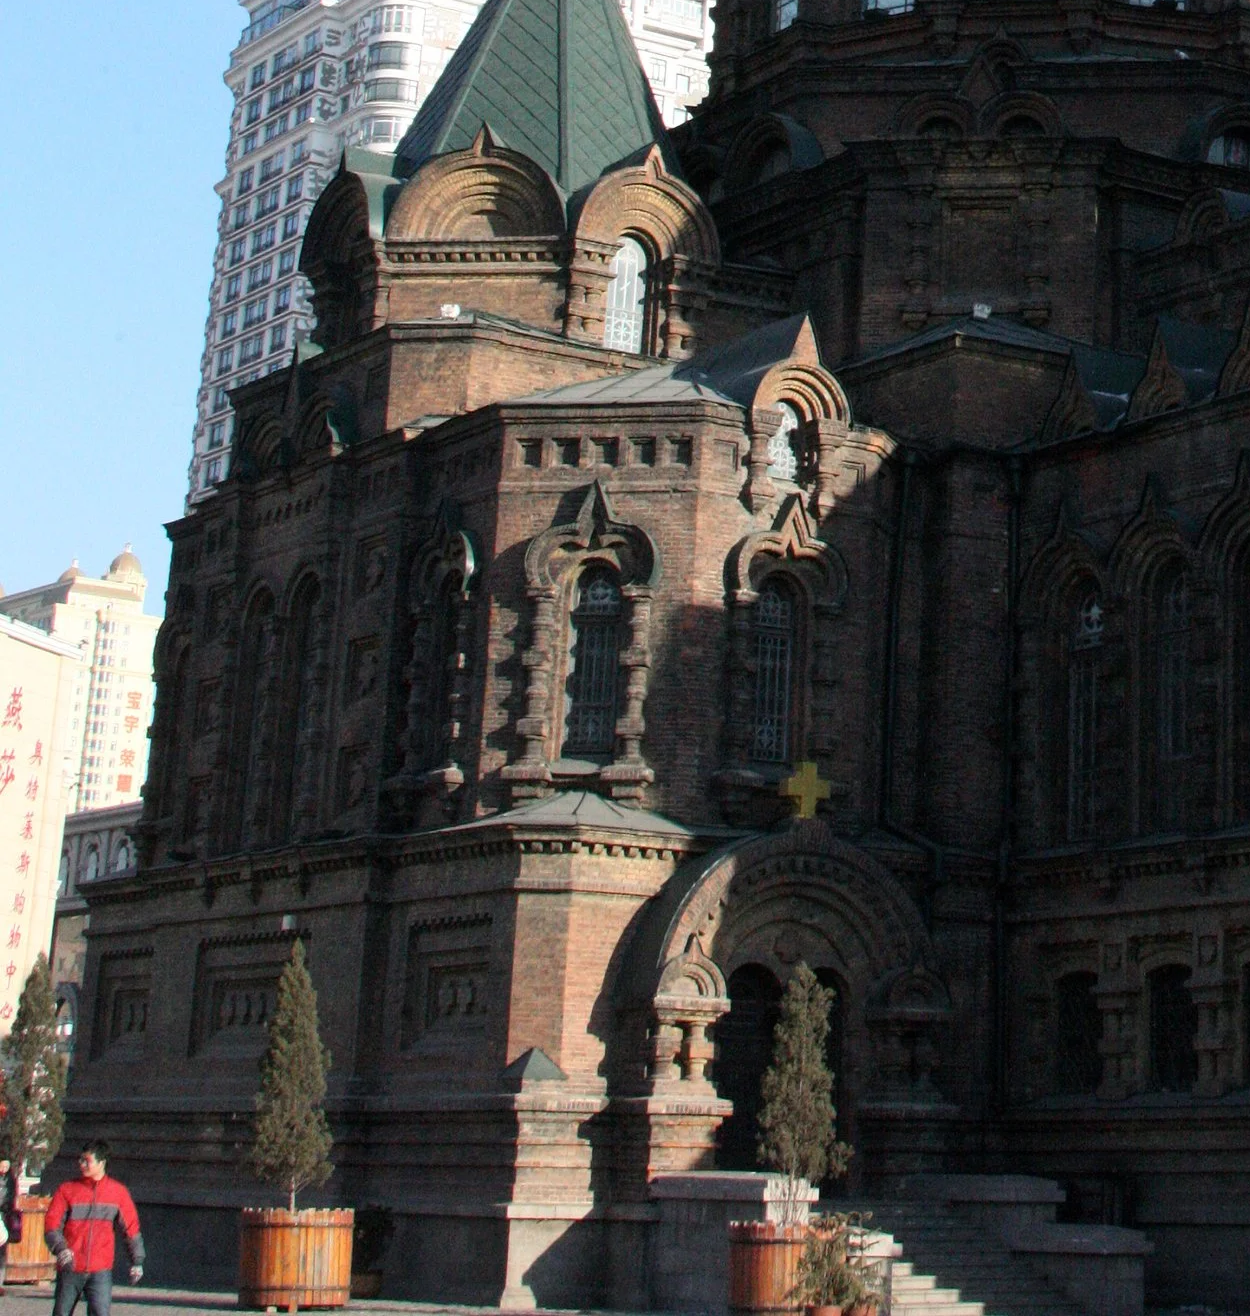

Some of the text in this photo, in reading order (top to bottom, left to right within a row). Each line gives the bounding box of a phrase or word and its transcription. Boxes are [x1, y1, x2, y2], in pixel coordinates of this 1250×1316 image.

[0, 738, 43, 1020] 奥特莱斯购物中心
